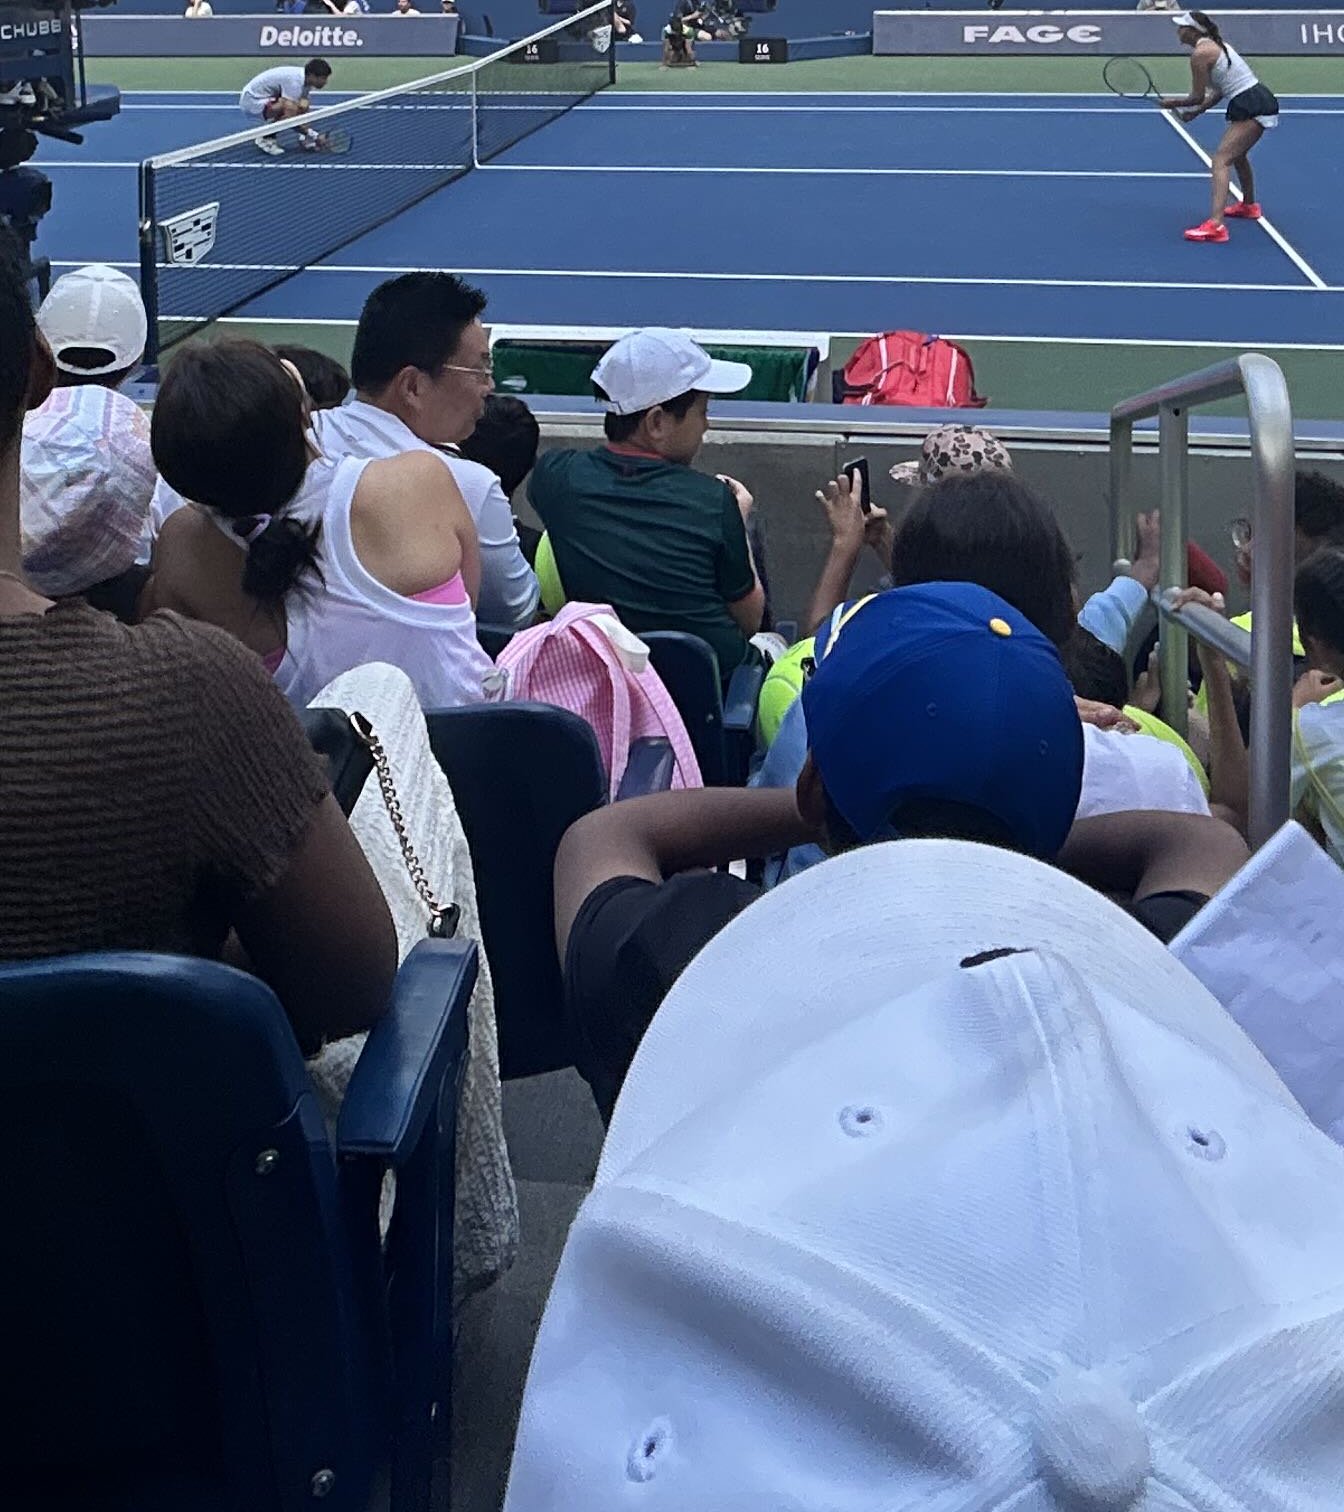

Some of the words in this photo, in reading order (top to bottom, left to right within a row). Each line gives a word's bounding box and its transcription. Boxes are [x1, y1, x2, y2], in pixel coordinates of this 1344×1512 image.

[0, 18, 62, 40] CHUBB
[260, 25, 364, 47] Deloitte.
[964, 24, 1102, 44] FAGE
[526, 44, 538, 55] 16
[756, 43, 769, 54] 16
